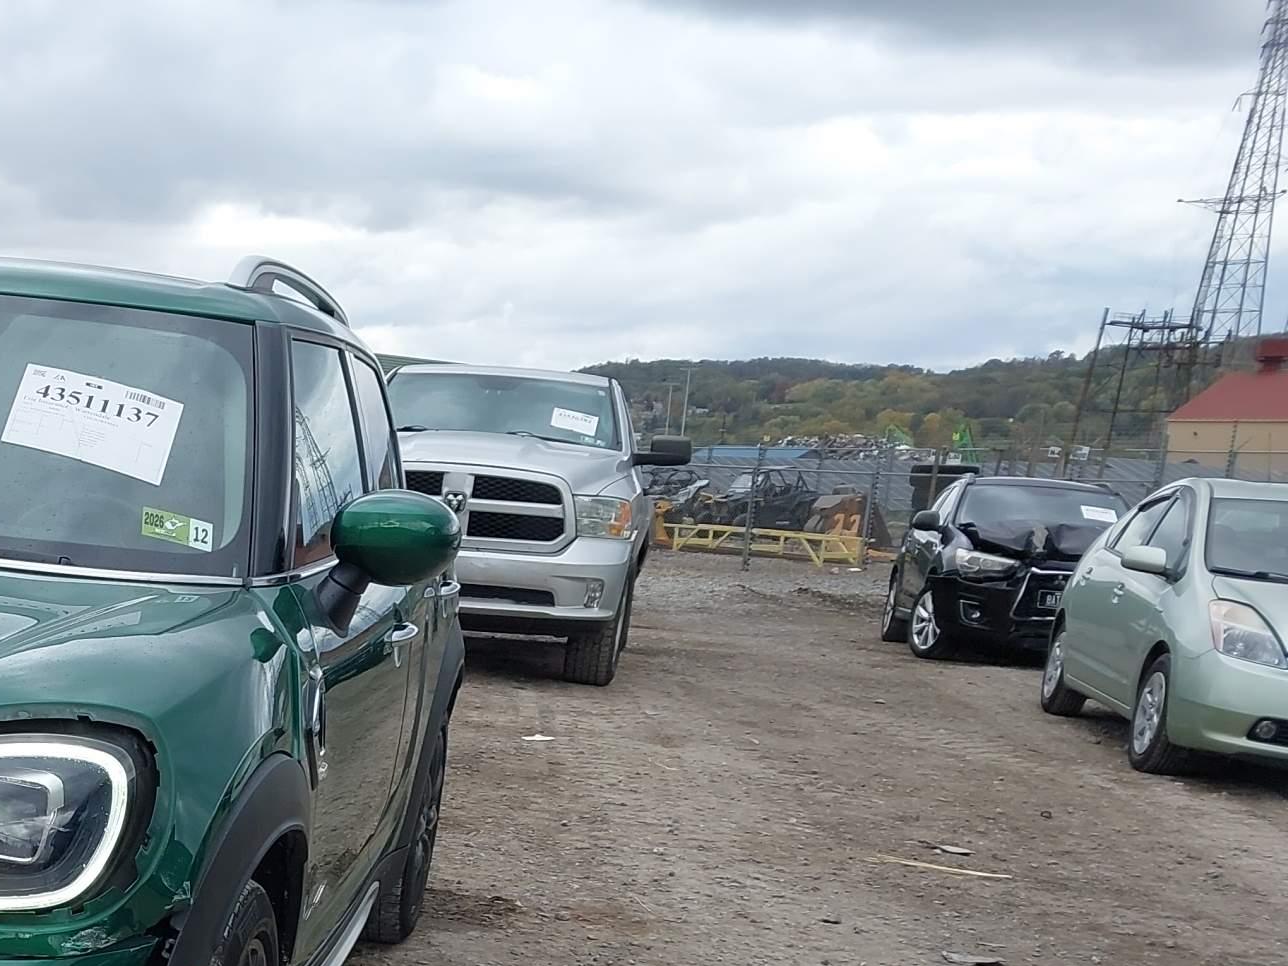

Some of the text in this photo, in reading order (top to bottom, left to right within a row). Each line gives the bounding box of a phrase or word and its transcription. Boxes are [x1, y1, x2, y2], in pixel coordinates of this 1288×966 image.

[35, 384, 160, 428] 43511137
[143, 511, 165, 529] 2026
[193, 526, 209, 544] 12
